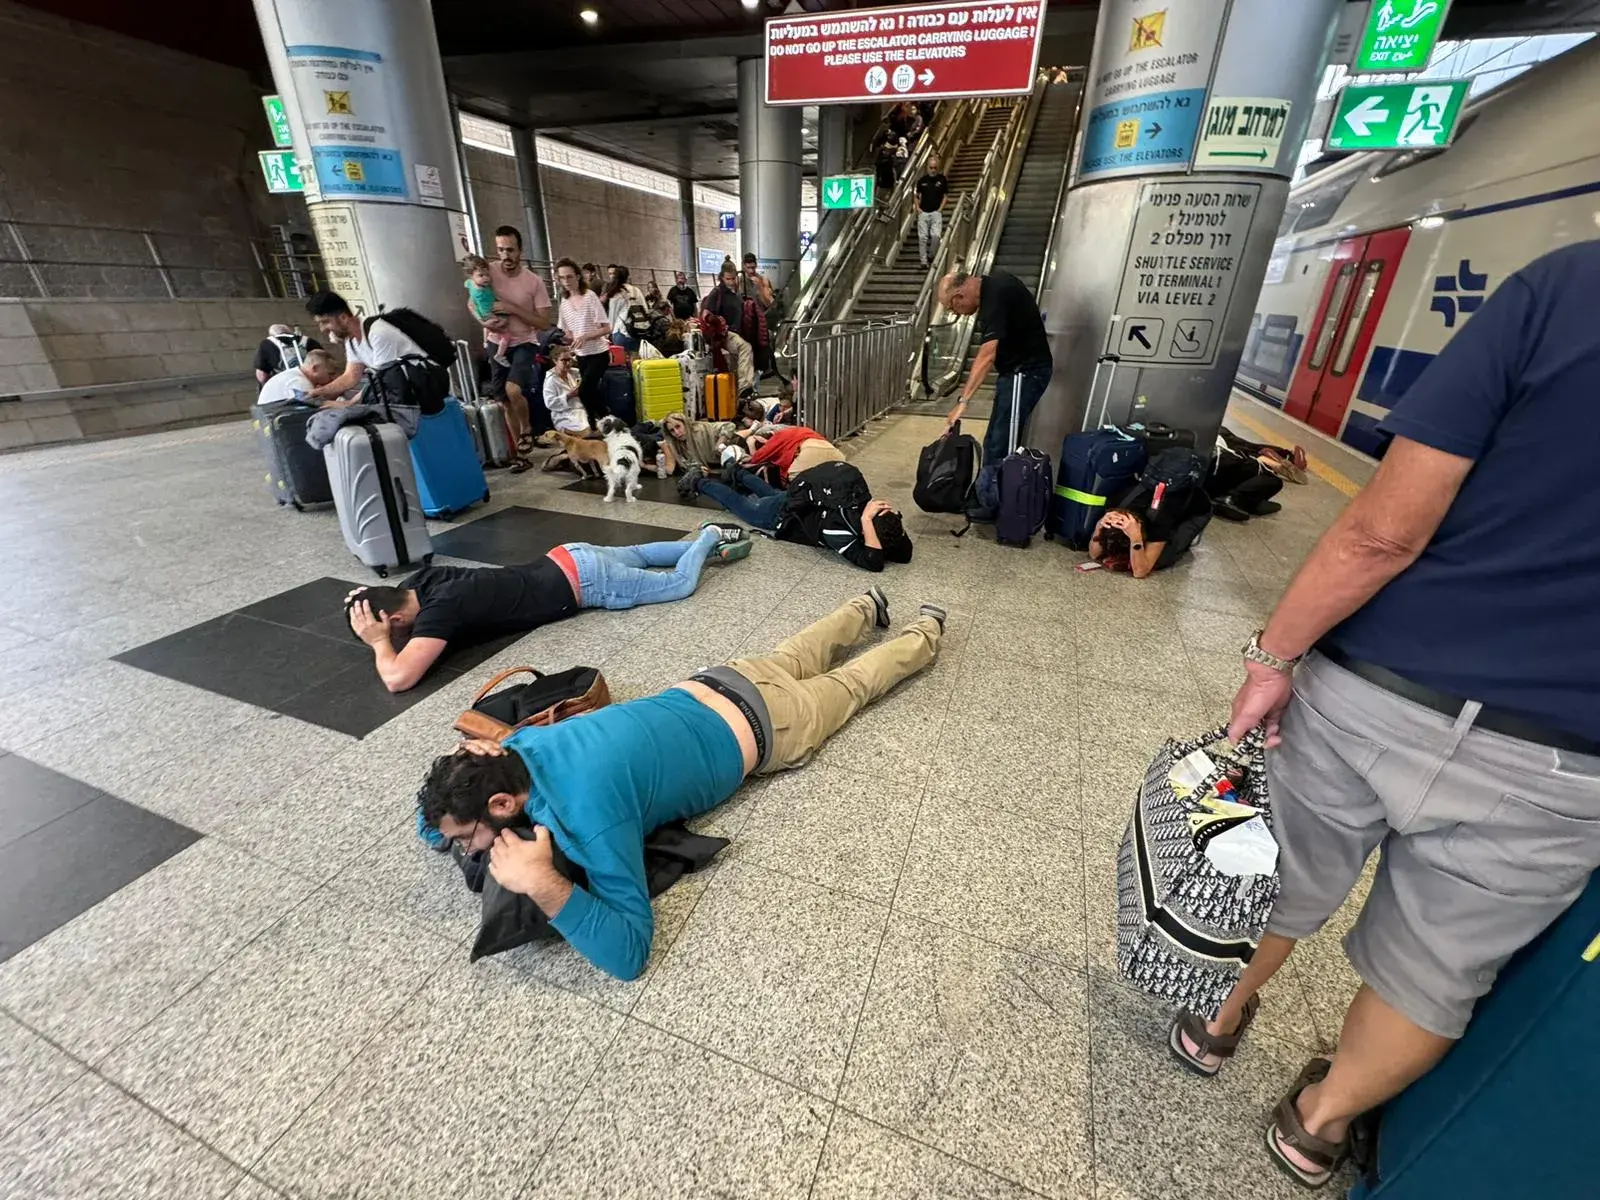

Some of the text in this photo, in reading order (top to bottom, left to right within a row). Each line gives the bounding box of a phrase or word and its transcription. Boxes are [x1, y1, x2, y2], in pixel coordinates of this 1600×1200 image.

[907, 13, 945, 28] כבודה
[948, 11, 969, 26] עם
[971, 5, 1015, 24] לעלות
[1016, 5, 1038, 24] אין
[821, 16, 878, 36] להשתמש
[879, 18, 895, 31] נא
[770, 25, 818, 40] במעליות
[770, 45, 784, 56] DO
[785, 43, 805, 55] NOT
[806, 42, 821, 53] GO
[822, 41, 836, 52] UP
[836, 39, 856, 50] THE
[857, 33, 917, 50] ESCALATOR
[918, 29, 973, 45] CARRYING
[974, 26, 1029, 41] LUGGAGE
[1373, 33, 1420, 50] יציאה
[824, 45, 967, 66] PLEASE USE THE ELEVATORS
[1369, 51, 1392, 62] EXIT
[1174, 96, 1190, 108] נא
[1204, 104, 1288, 141] למרחב מוגן
[1120, 151, 1134, 162] THE
[1136, 147, 1184, 161] ELEVATORS
[1149, 193, 1251, 208] שרות הסעה פנימי
[1178, 210, 1226, 226] לטרמינל
[1150, 229, 1232, 249] דרך מפלס 2
[1189, 256, 1233, 271] SERVICE
[1140, 274, 1222, 288] TO TERMINAL 1
[1138, 291, 1217, 306] VIA LEVEL 2
